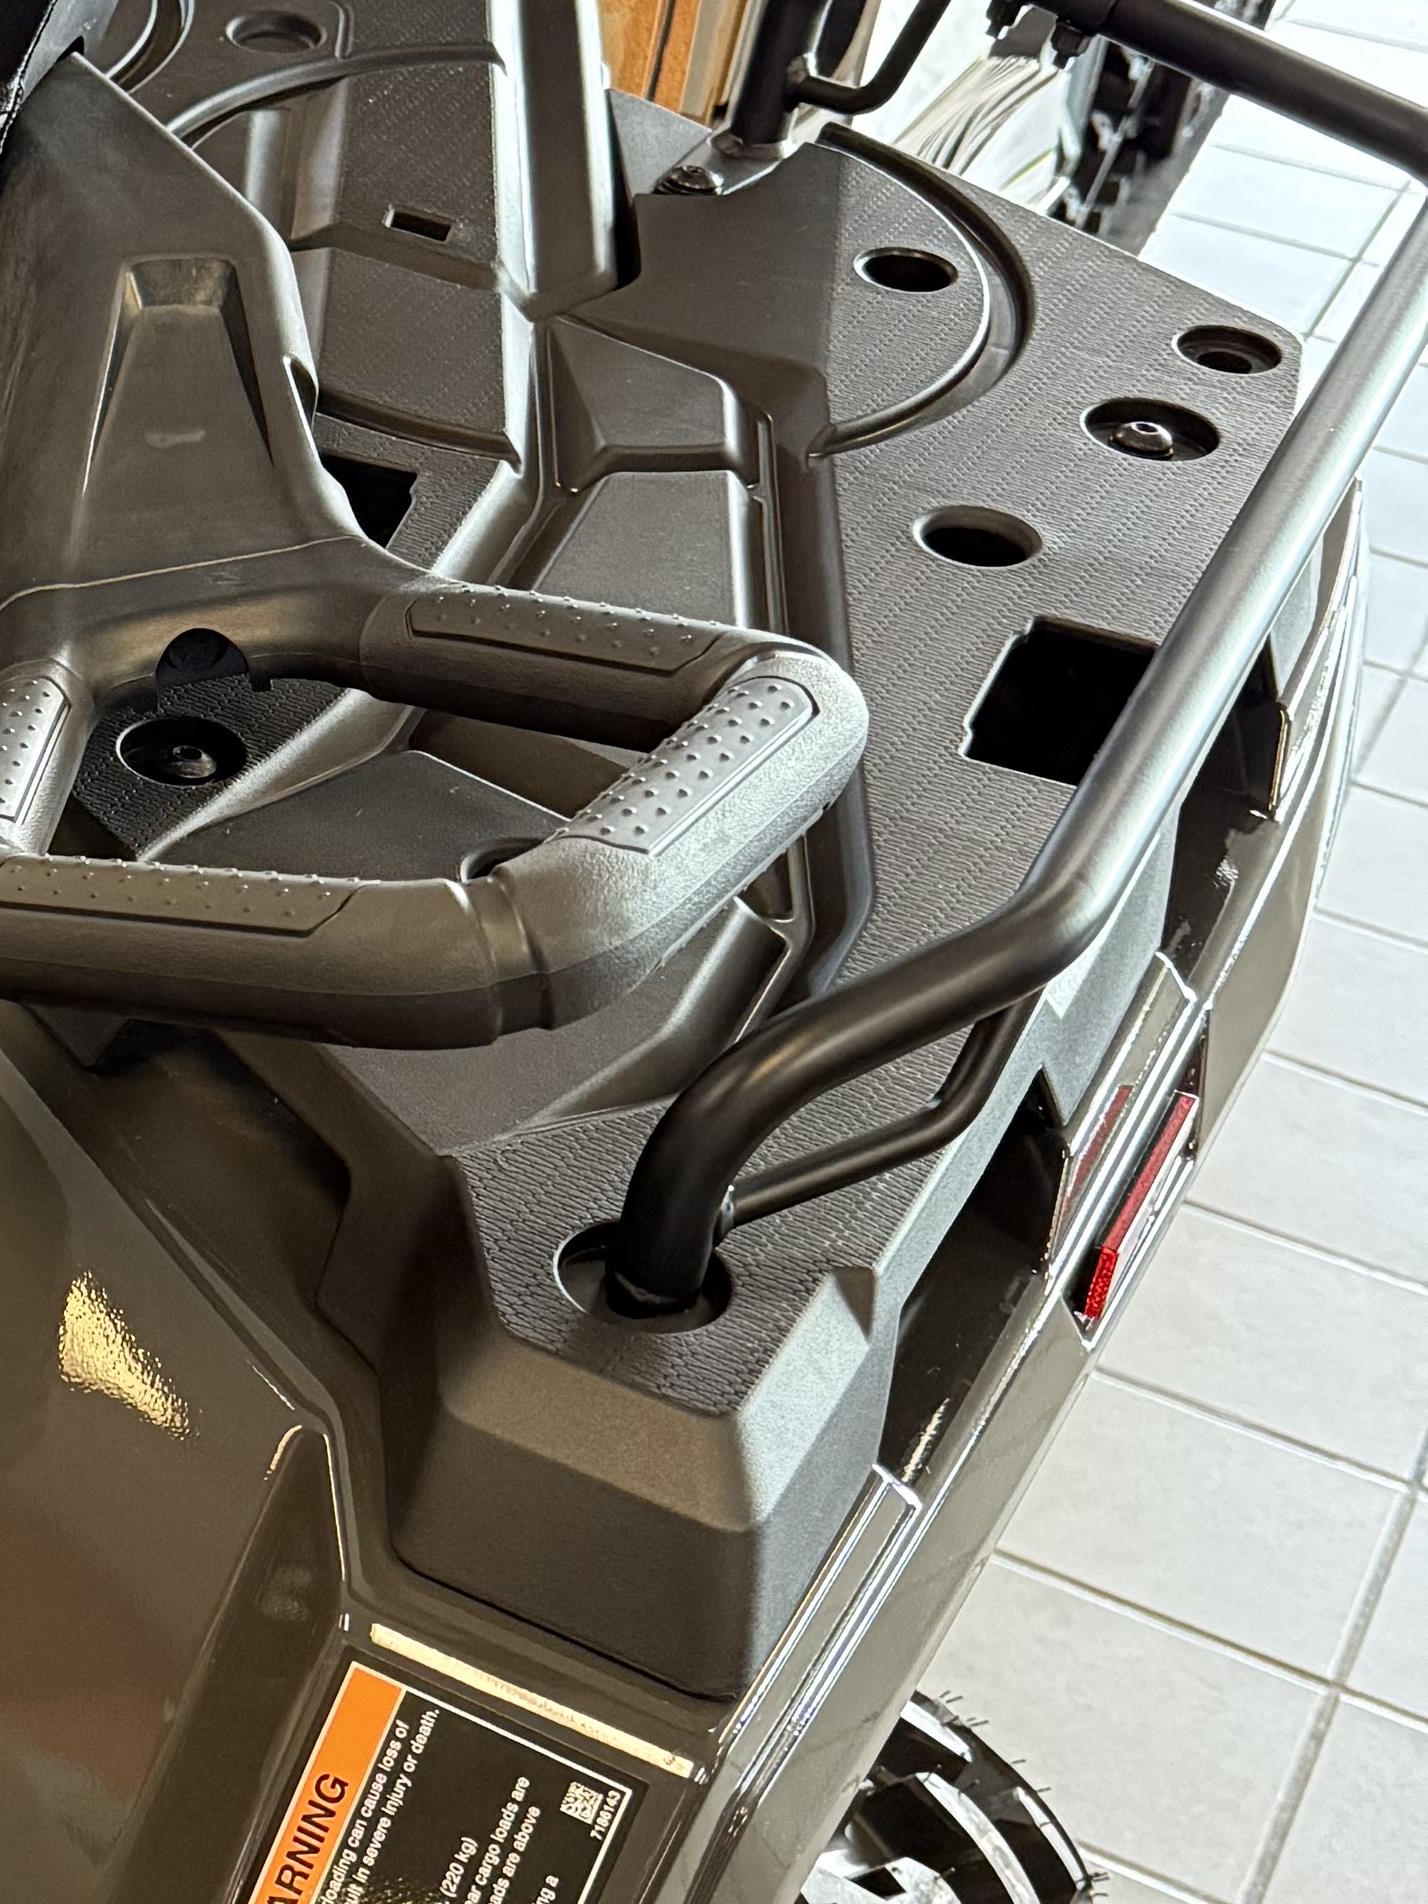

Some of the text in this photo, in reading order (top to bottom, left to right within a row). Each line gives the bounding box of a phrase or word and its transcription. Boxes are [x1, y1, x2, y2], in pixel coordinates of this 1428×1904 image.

[407, 1703, 439, 1754] death.
[347, 1818, 367, 1848] can
[360, 1771, 387, 1818] cause
[377, 1737, 401, 1771] loss
[391, 1718, 410, 1739] of
[403, 1754, 418, 1773] or
[381, 1771, 413, 1817] injury
[360, 1814, 392, 1867] severe
[474, 1842, 503, 1887] cargo
[490, 1799, 519, 1843] loads
[510, 1774, 530, 1802] are
[509, 1803, 541, 1852] above
[353, 1865, 371, 1884] in
[438, 1861, 467, 1899] (220
[453, 1834, 479, 1864] kg)
[501, 1850, 520, 1877] are
[545, 1873, 559, 1887] a
